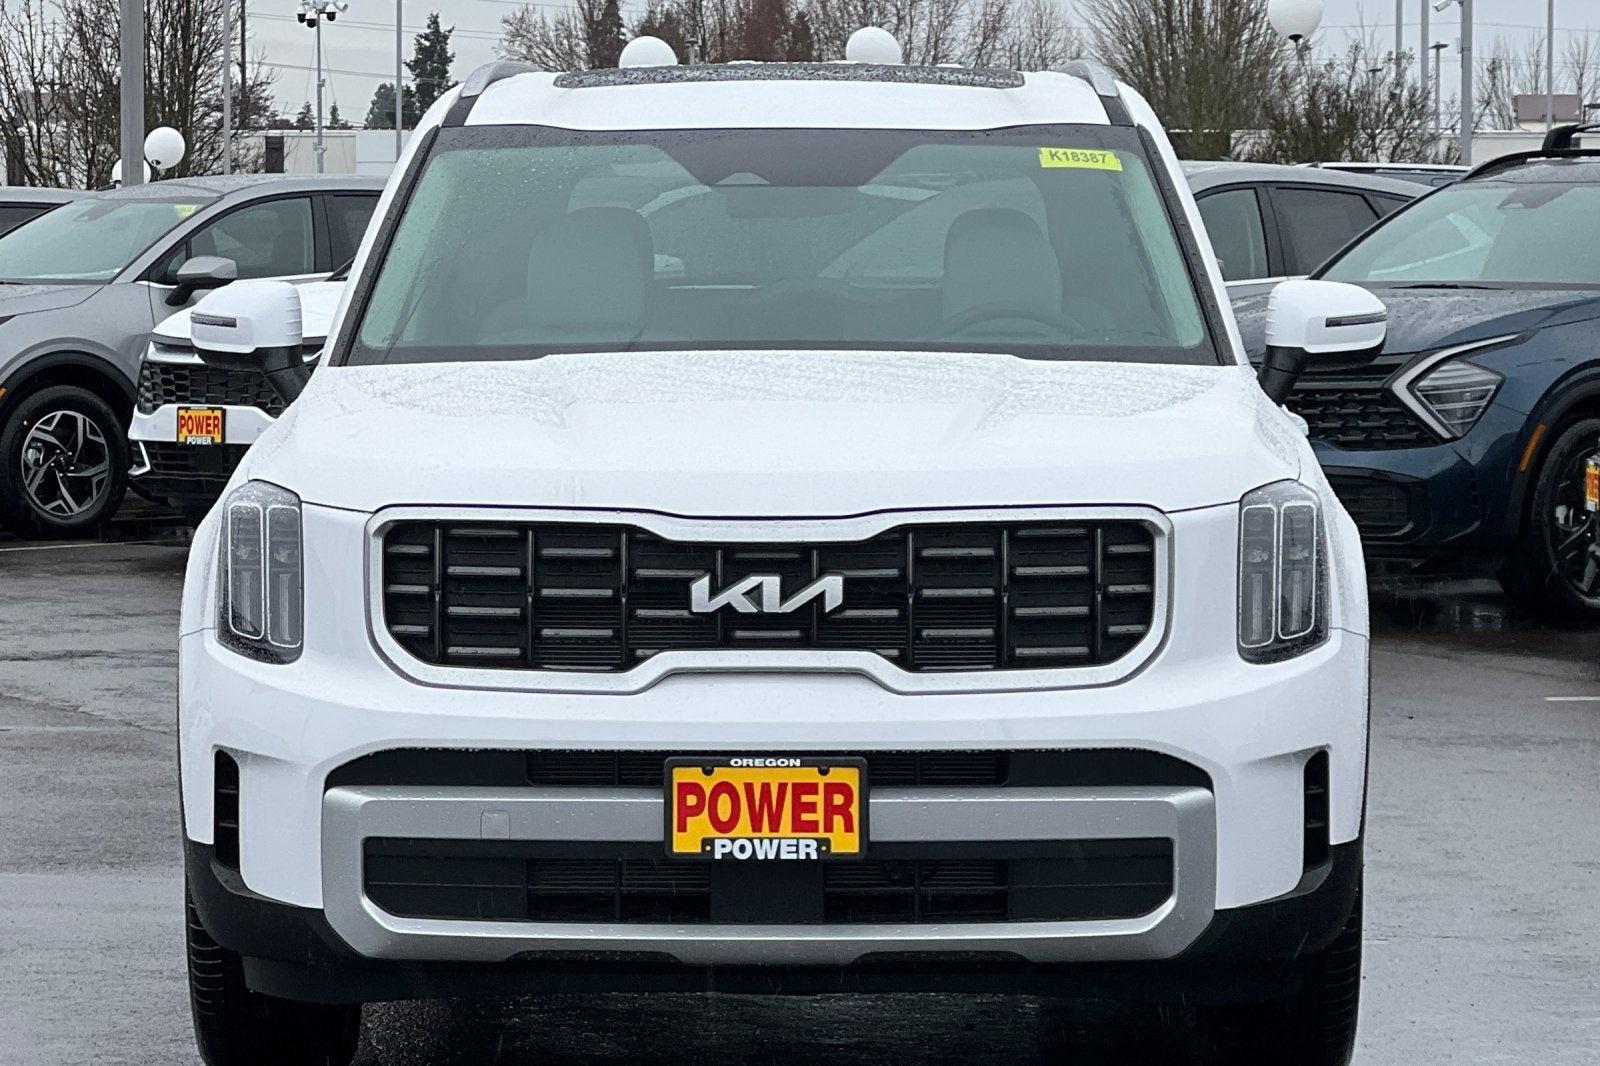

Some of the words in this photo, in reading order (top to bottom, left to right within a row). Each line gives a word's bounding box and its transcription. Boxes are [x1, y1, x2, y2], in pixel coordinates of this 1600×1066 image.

[1049, 150, 1106, 163] K18387
[180, 415, 219, 434] POWER
[187, 437, 211, 445] POWER
[691, 574, 844, 613] KIA
[730, 758, 800, 767] OREGON
[677, 781, 854, 834] POWER
[714, 839, 817, 860] POWER
